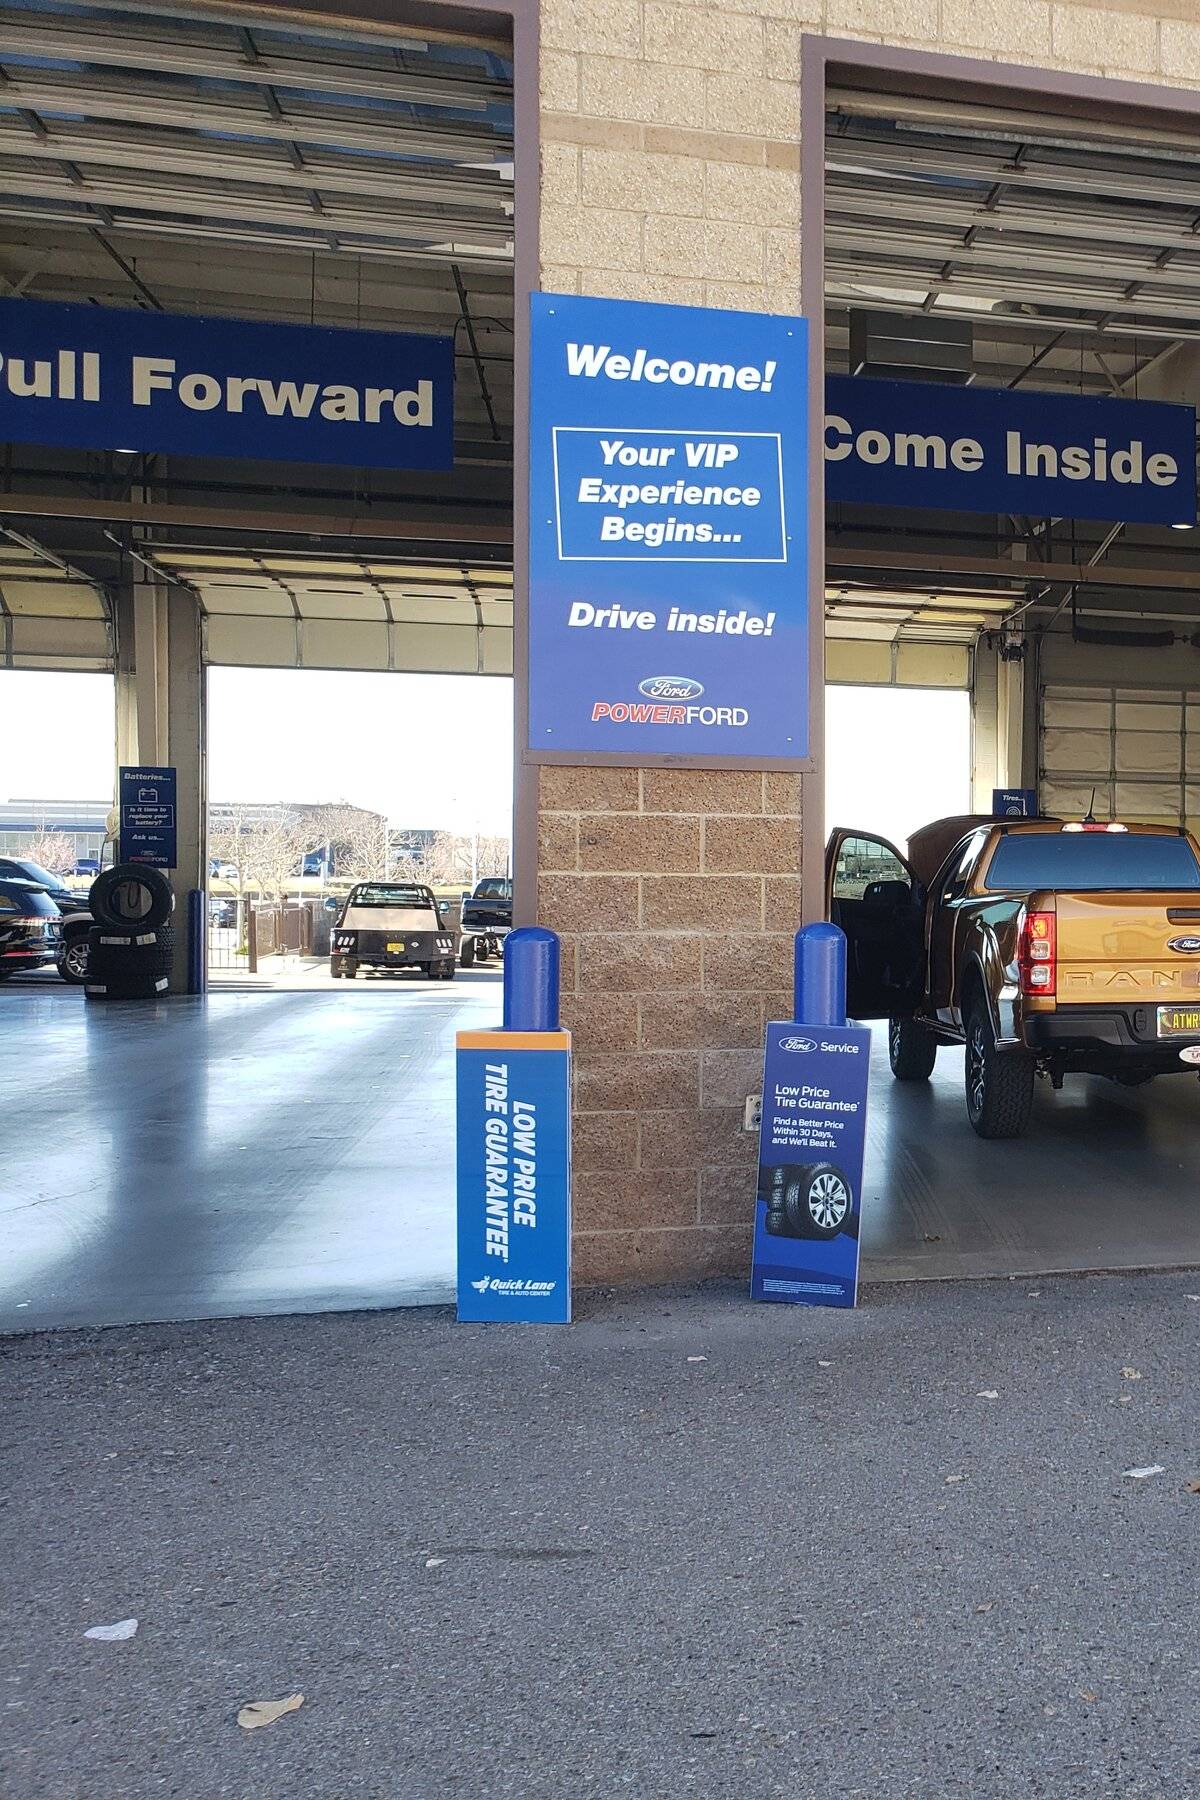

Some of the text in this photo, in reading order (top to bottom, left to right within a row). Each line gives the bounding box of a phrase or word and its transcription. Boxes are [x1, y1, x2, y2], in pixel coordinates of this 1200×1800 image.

[566, 343, 777, 392] Welcome!
[0, 350, 433, 427] ull Forward
[600, 440, 739, 468] Your VIP
[824, 415, 1178, 486] Come Inside
[577, 478, 761, 509] Experience
[600, 516, 742, 548] Begins...
[568, 602, 776, 636] Drive inside!
[821, 1042, 859, 1053] Service
[485, 1063, 508, 1115] TIRE
[774, 1097, 796, 1107] Tire
[775, 1084, 830, 1097] Low Price
[773, 1117, 791, 1125] Find
[799, 1119, 823, 1127] Better
[824, 1120, 844, 1129] Price
[773, 1127, 798, 1135] Within
[809, 1139, 828, 1147] Beat
[513, 1101, 536, 1228] LOW PRICE
[490, 1279, 555, 1290] Quick Lane
